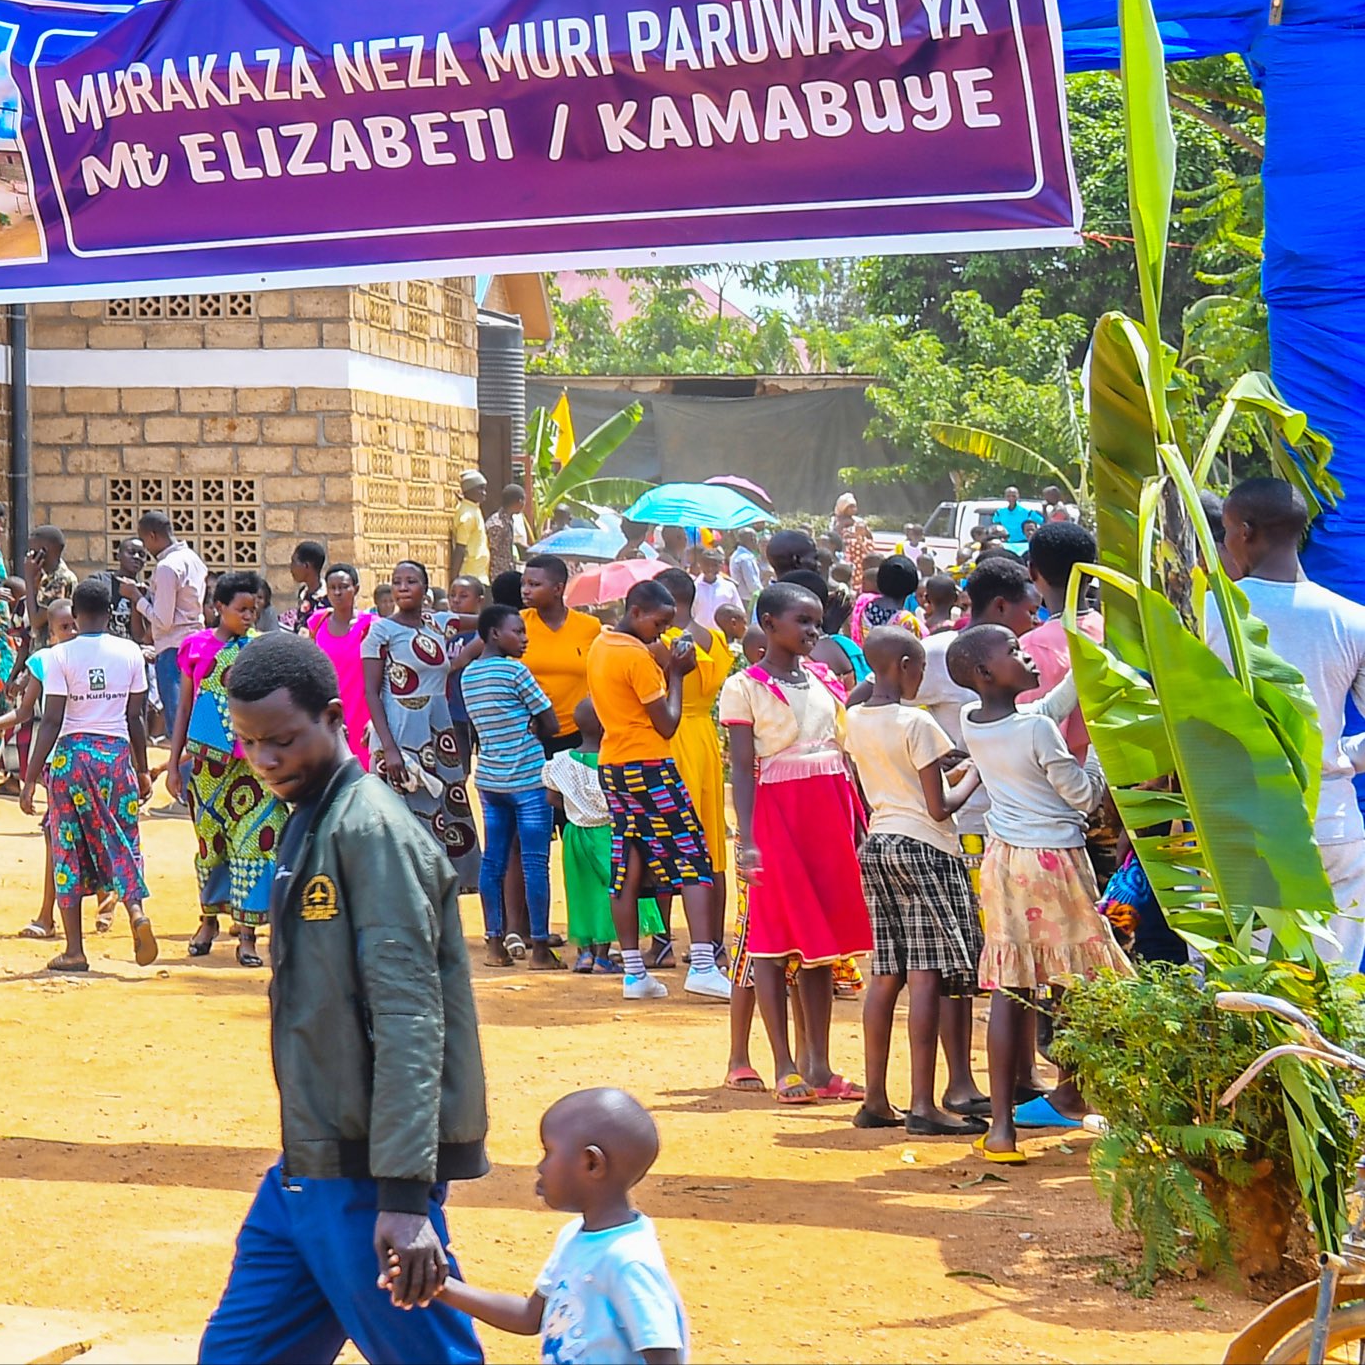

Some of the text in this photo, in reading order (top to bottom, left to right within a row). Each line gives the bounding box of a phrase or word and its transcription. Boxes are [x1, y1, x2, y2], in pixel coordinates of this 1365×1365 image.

[55, 46, 326, 134] MURAKAZA
[333, 32, 471, 94] NEZA
[479, 14, 614, 82] MURI
[81, 68, 1001, 196] Mt ELIZABETI / KAMABUYE
